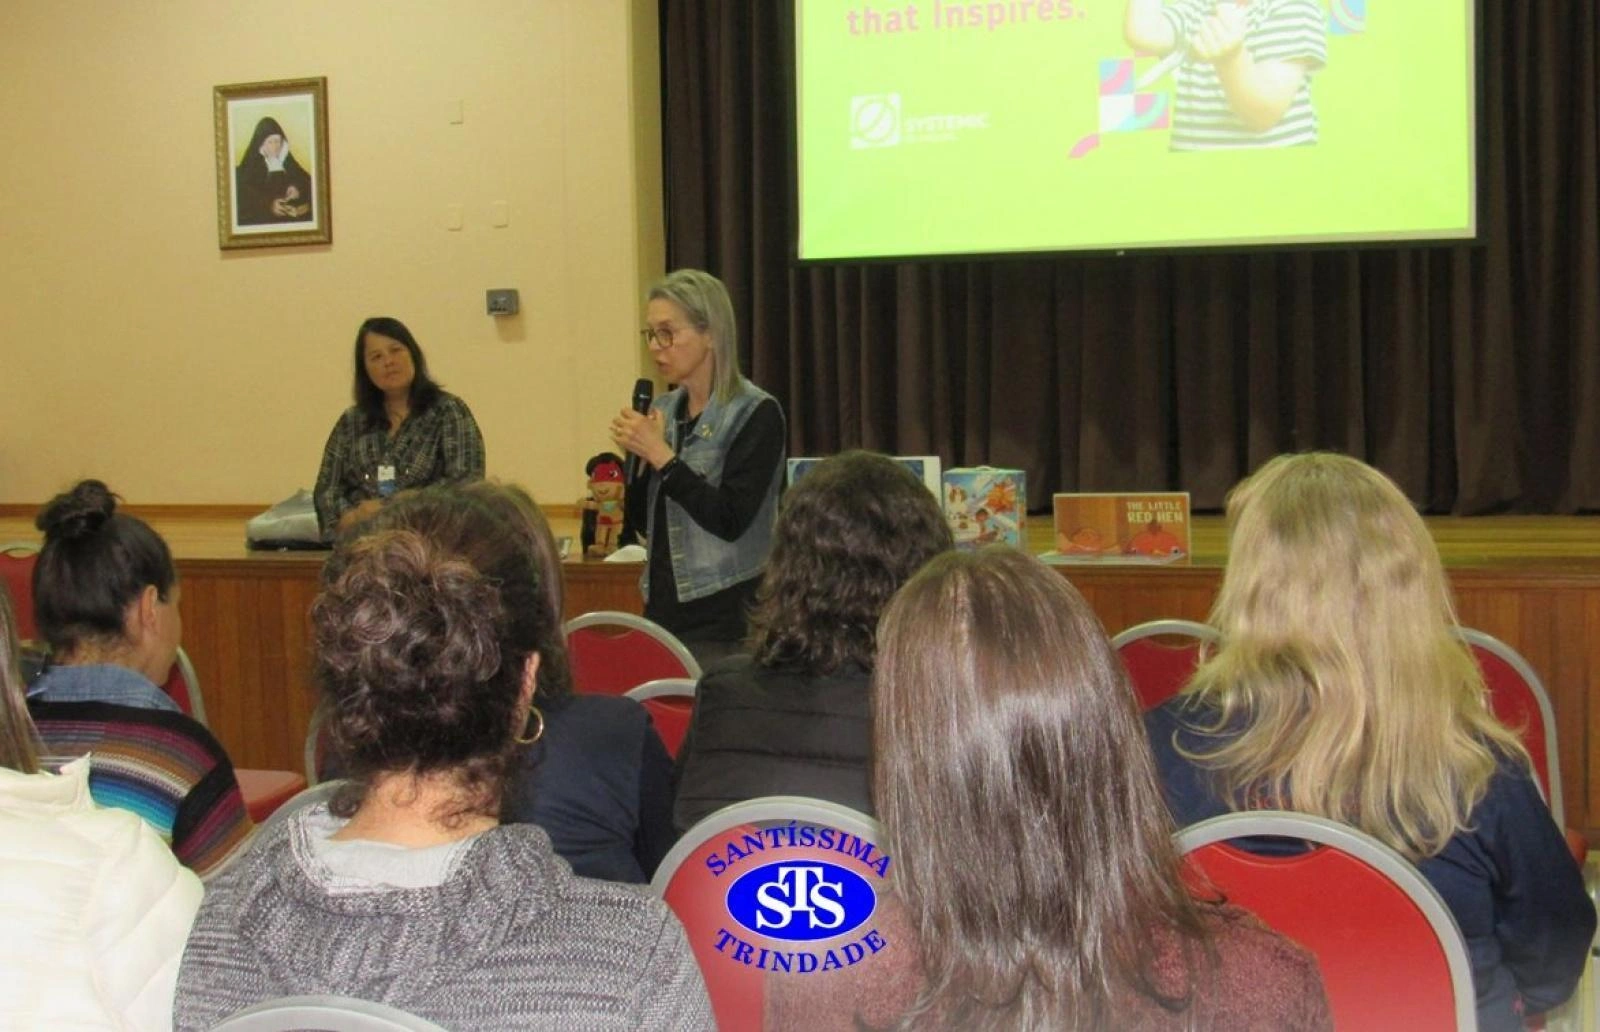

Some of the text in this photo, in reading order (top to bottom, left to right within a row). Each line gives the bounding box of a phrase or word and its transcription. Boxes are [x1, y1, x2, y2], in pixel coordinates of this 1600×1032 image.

[847, 5, 918, 35] that
[1127, 502, 1181, 511] THE LITTLE
[1128, 512, 1184, 524] RED HEN
